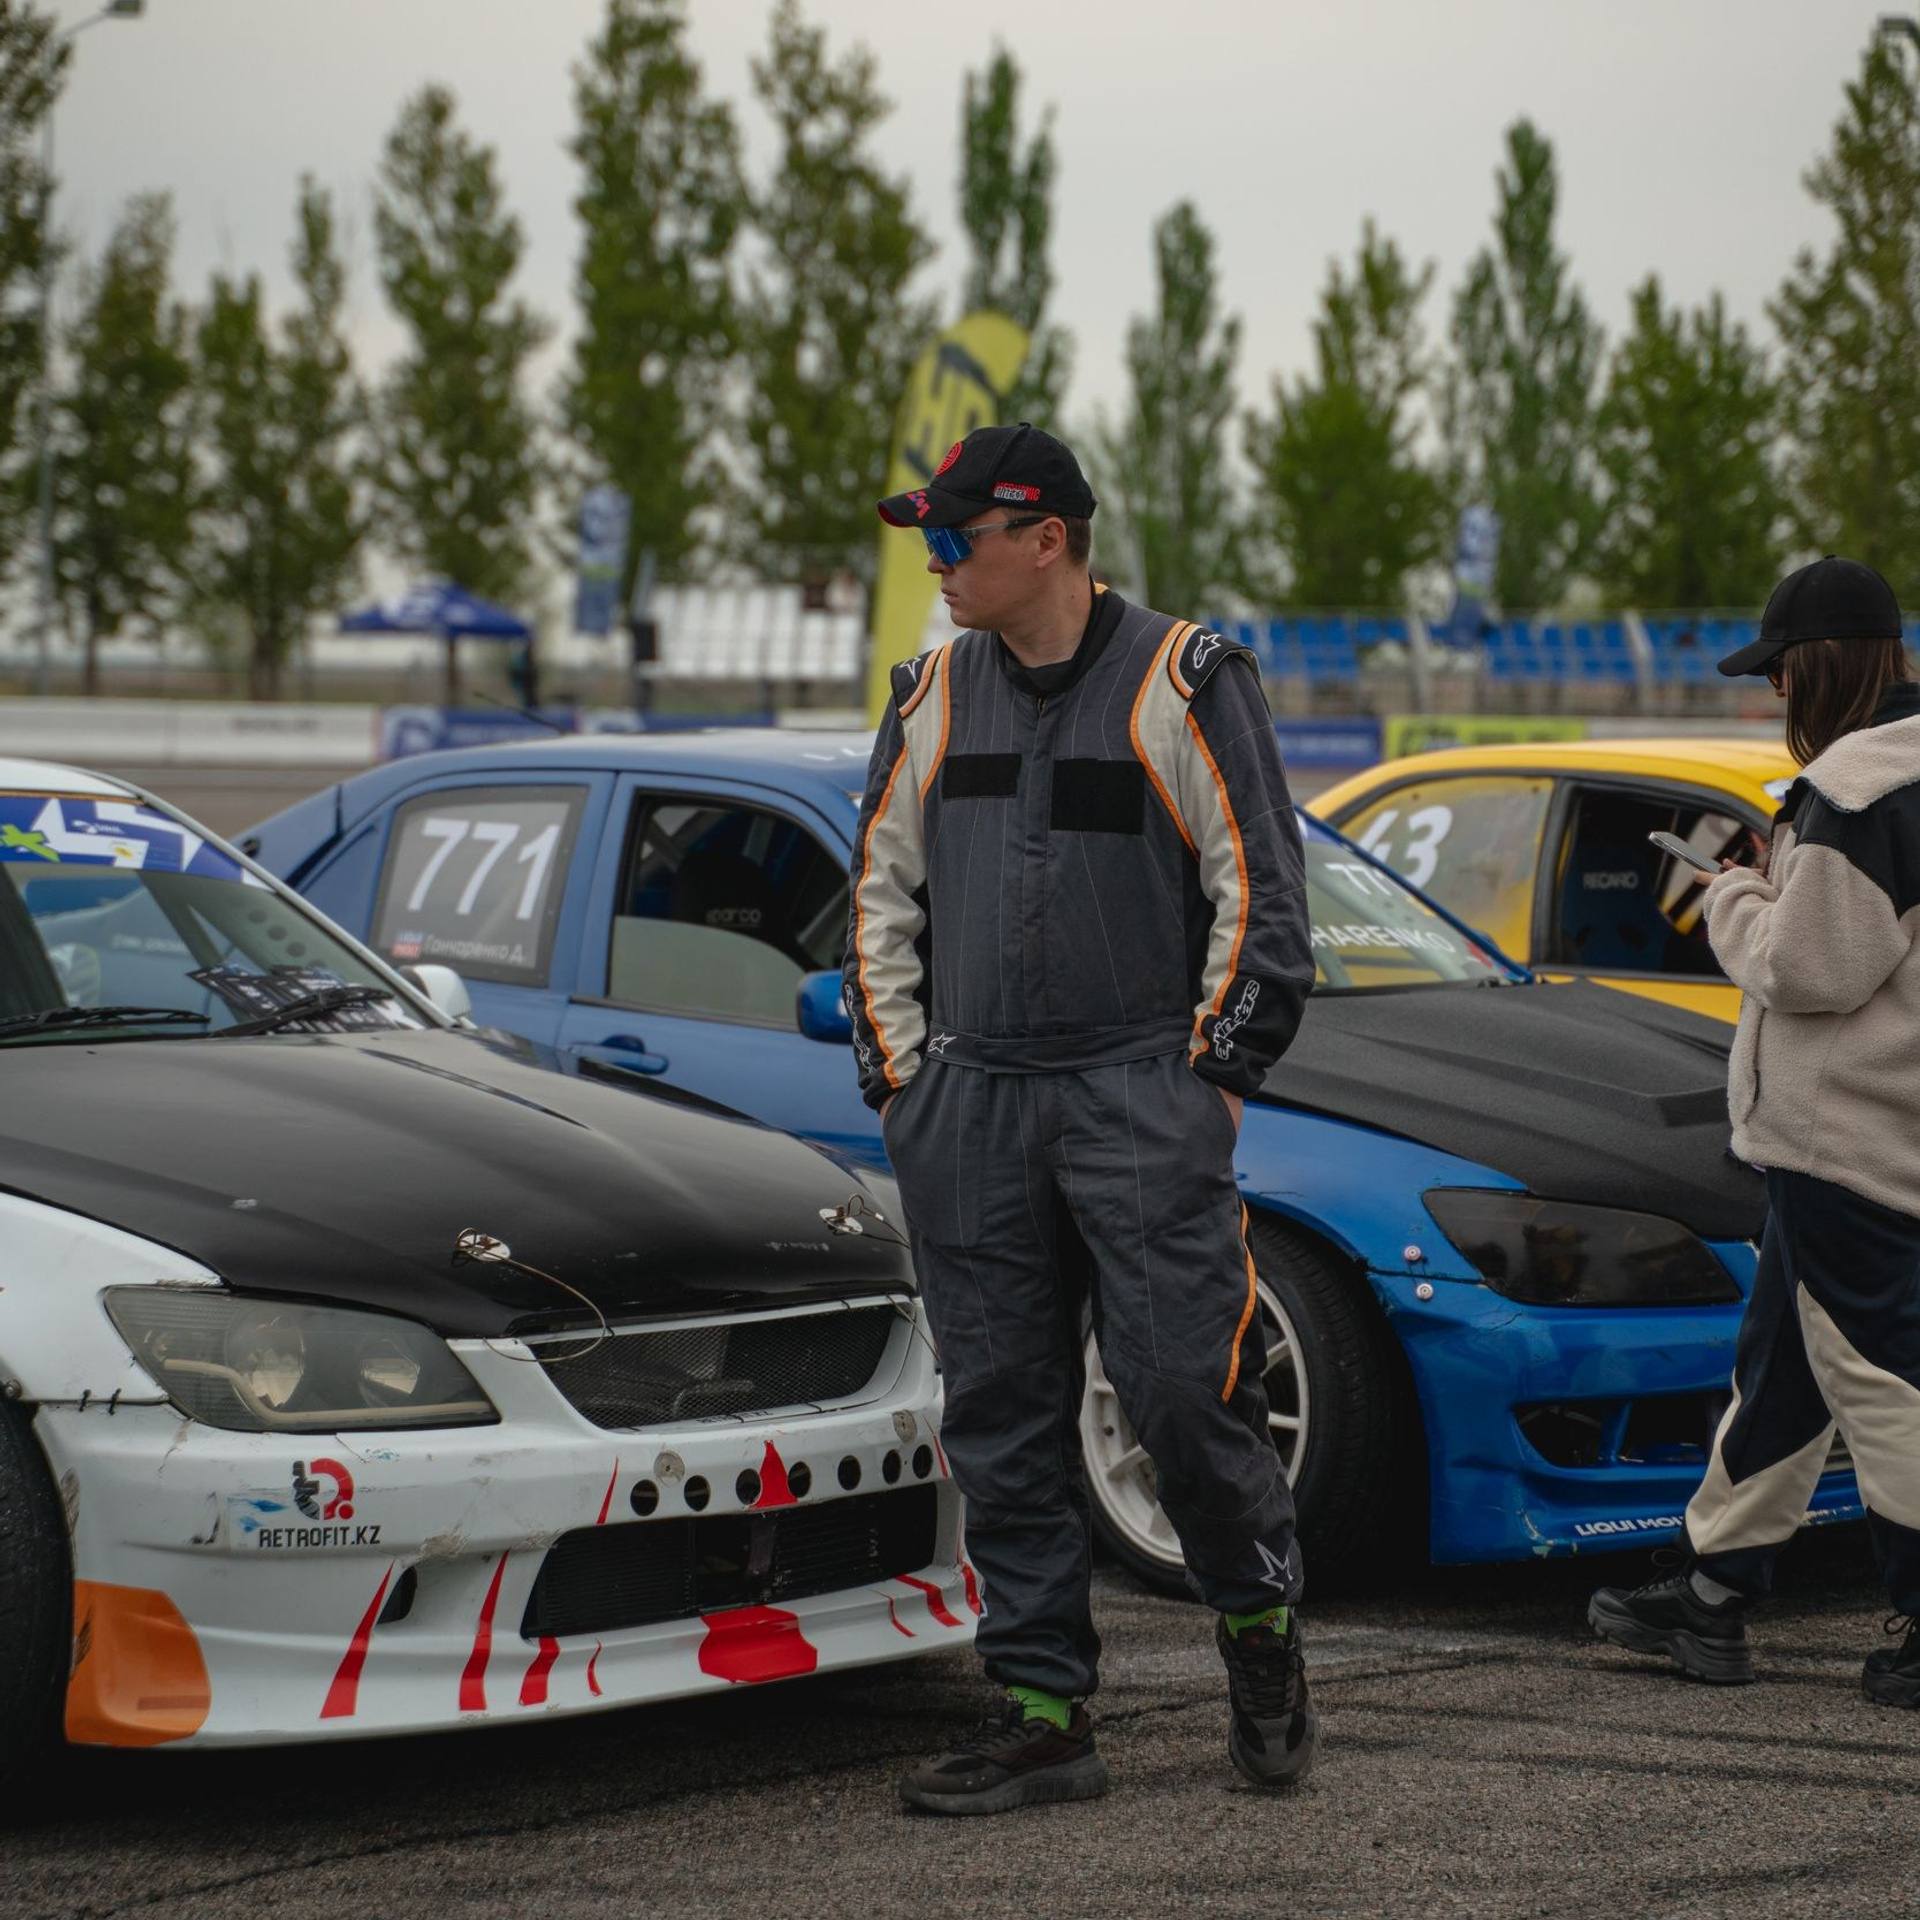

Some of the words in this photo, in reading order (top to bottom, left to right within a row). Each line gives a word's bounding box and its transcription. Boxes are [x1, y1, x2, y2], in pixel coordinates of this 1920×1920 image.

[408, 817, 560, 920] 771
[1311, 925, 1457, 953] HARENKO
[259, 1525, 381, 1548] RETROFIT.KZ
[1575, 1519, 1636, 1537] LIQUI
[1637, 1515, 1684, 1529] MOL
